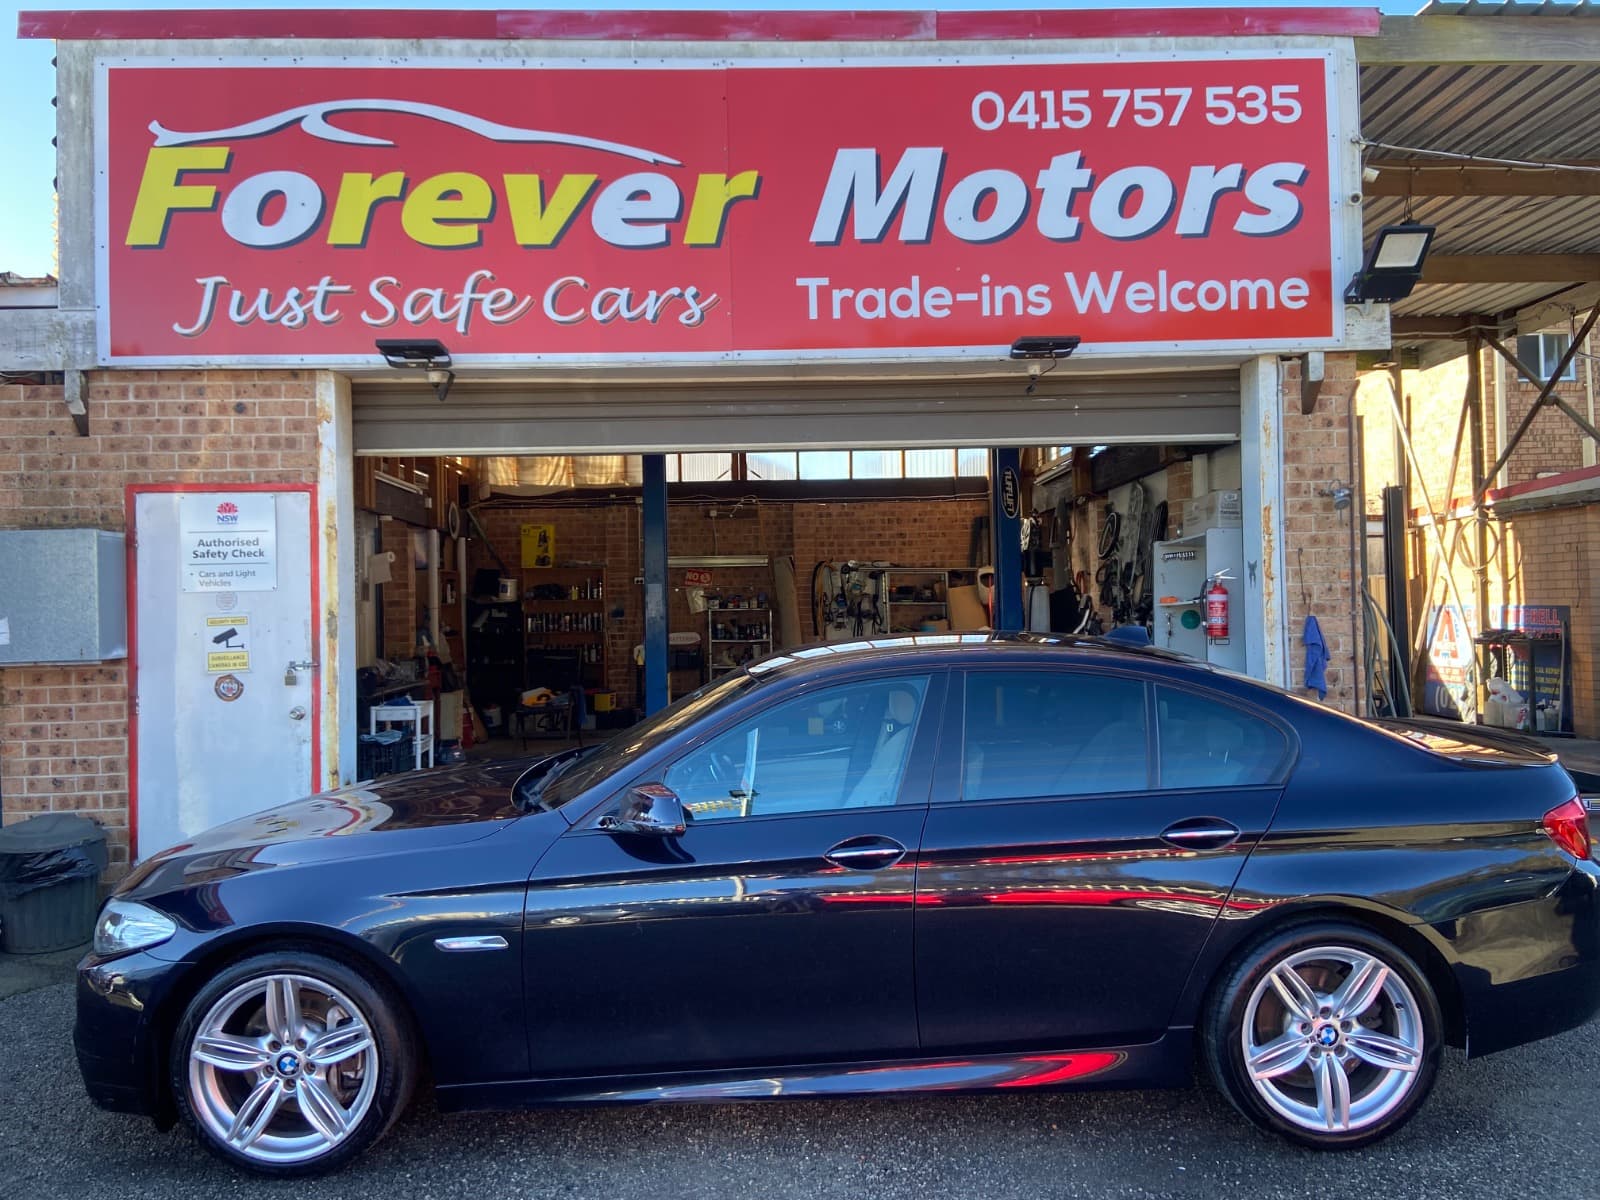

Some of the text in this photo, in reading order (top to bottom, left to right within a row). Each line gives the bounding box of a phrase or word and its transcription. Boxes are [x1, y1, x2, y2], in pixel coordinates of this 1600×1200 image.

[971, 84, 1302, 132] 0415 757 535
[125, 146, 1308, 248] Forever Motors
[173, 269, 719, 337] Just Safe Cars
[796, 270, 1311, 320] Trade-ins Welcome
[192, 548, 265, 560] Safety Check
[197, 537, 259, 547] Authorised
[199, 570, 217, 578] Cars
[235, 570, 256, 579] Light
[199, 579, 232, 587] Vehicles
